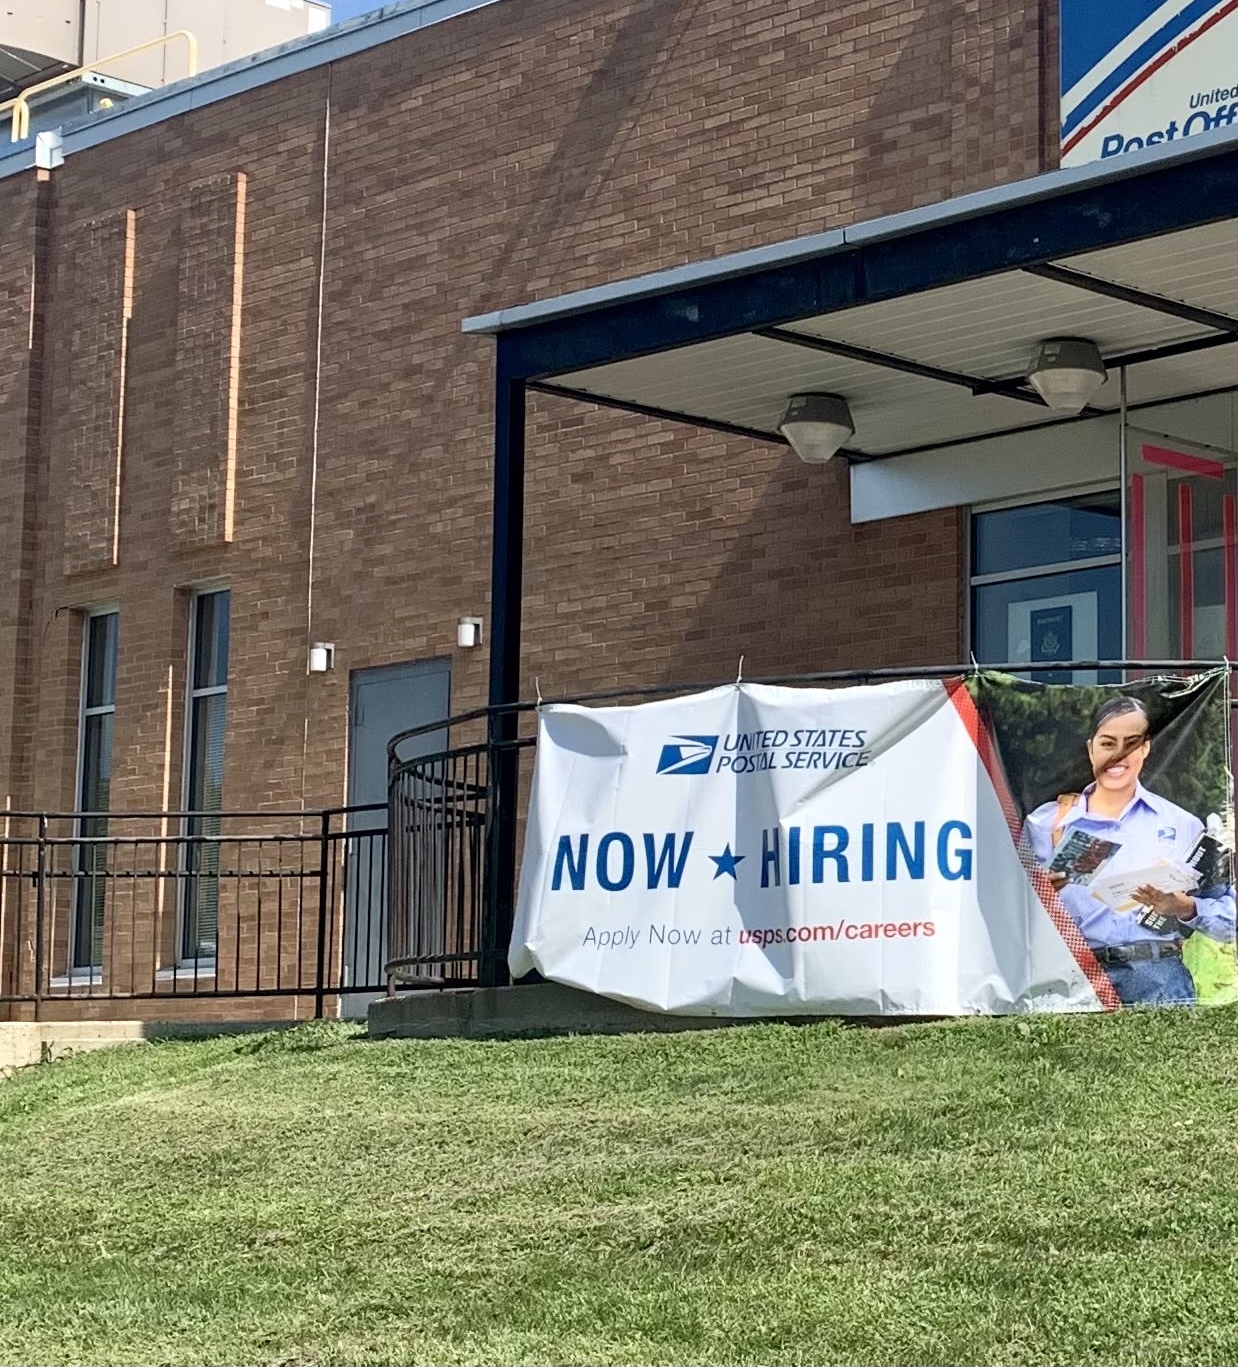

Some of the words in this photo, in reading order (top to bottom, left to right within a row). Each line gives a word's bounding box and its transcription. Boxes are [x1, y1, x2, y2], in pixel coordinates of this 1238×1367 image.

[723, 730, 789, 752] UNITED
[790, 729, 868, 748] STATES
[716, 751, 777, 774] POSTAL
[781, 749, 872, 770] SERVICE
[550, 830, 695, 892] NOW
[760, 820, 973, 890] HIRING
[582, 925, 640, 950] Apply
[648, 923, 701, 946] Now
[710, 921, 732, 946] at
[738, 919, 936, 950] usps.com/careers
